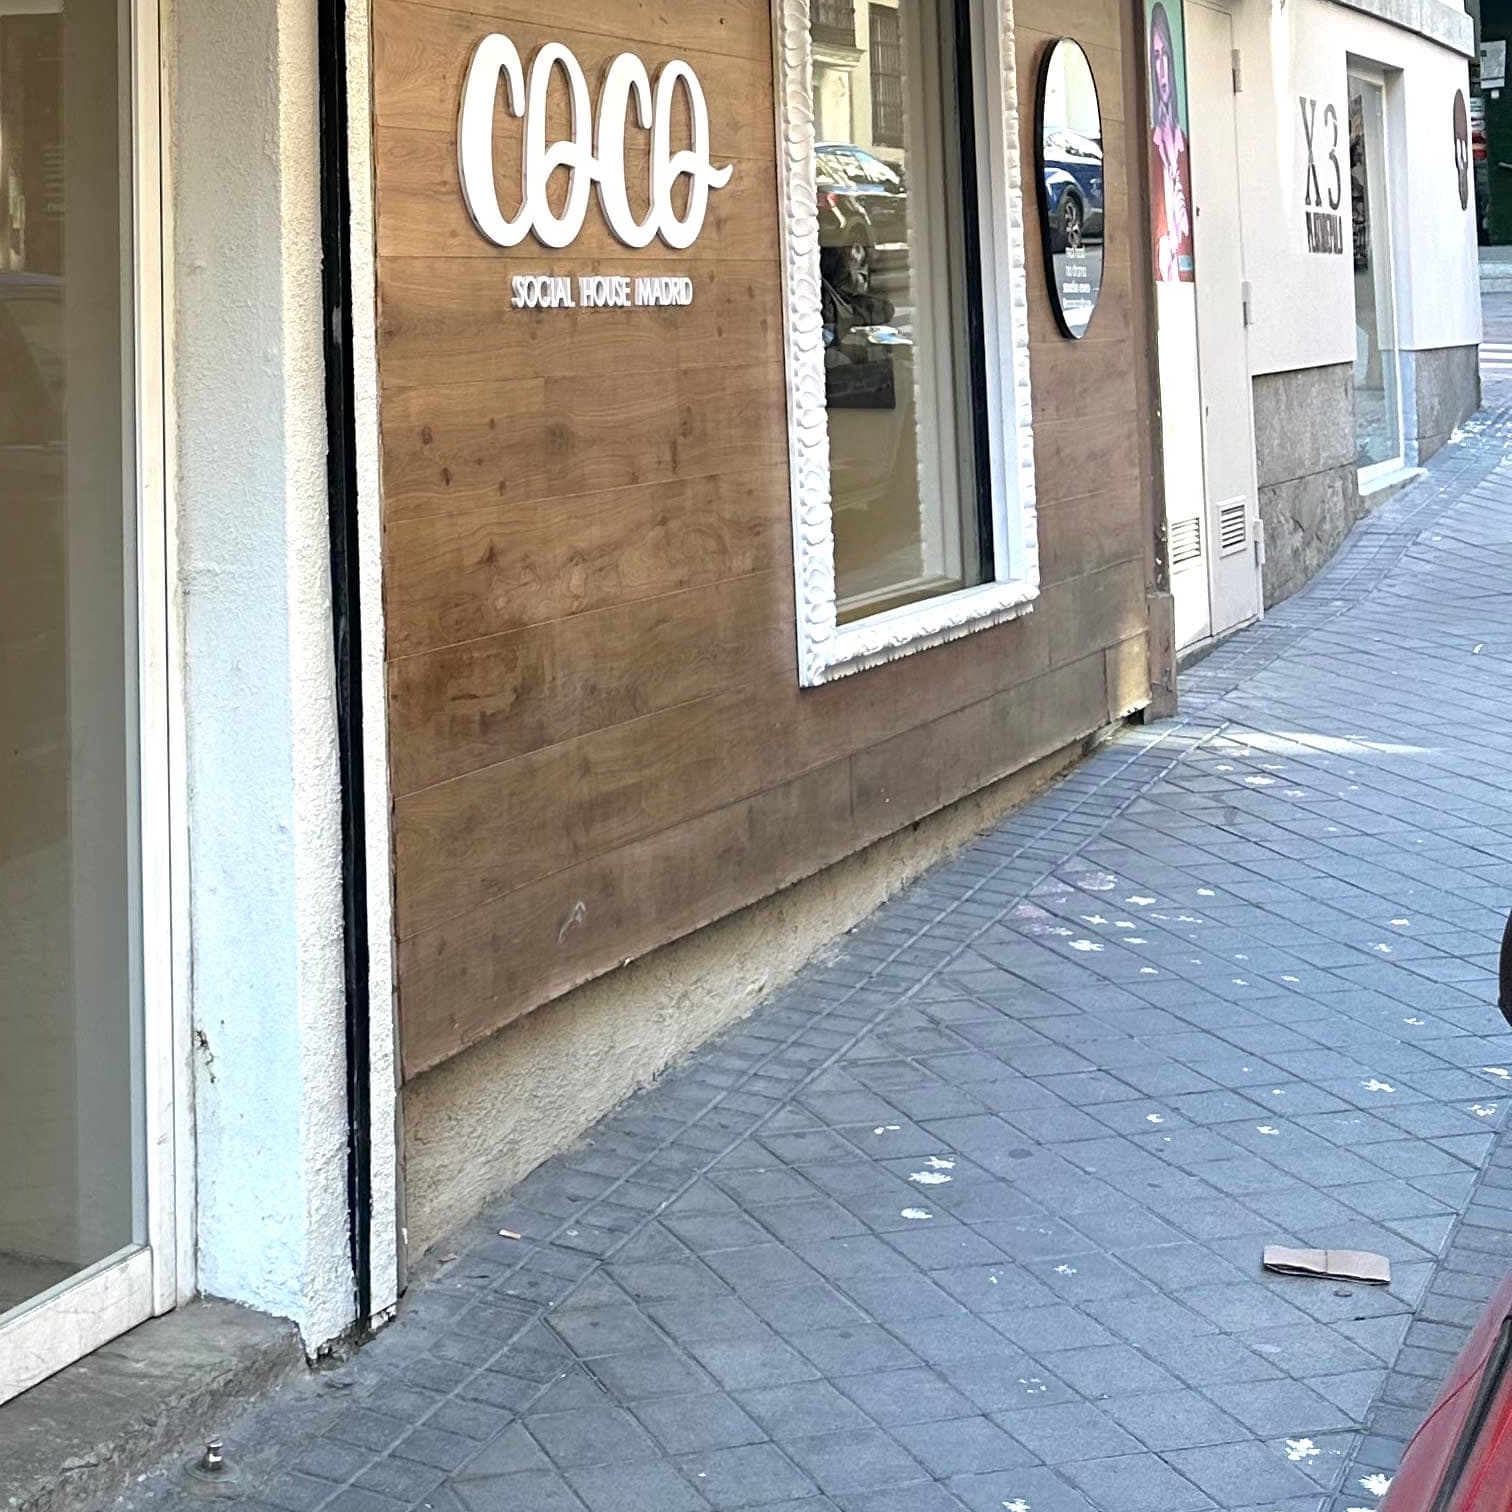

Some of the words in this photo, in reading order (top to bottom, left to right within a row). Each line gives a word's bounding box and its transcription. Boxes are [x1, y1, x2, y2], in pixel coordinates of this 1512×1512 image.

[457, 33, 734, 249] COCO
[511, 275, 576, 308] SOCIAL
[579, 275, 632, 307] HOUSE
[635, 276, 694, 306] MADRID
